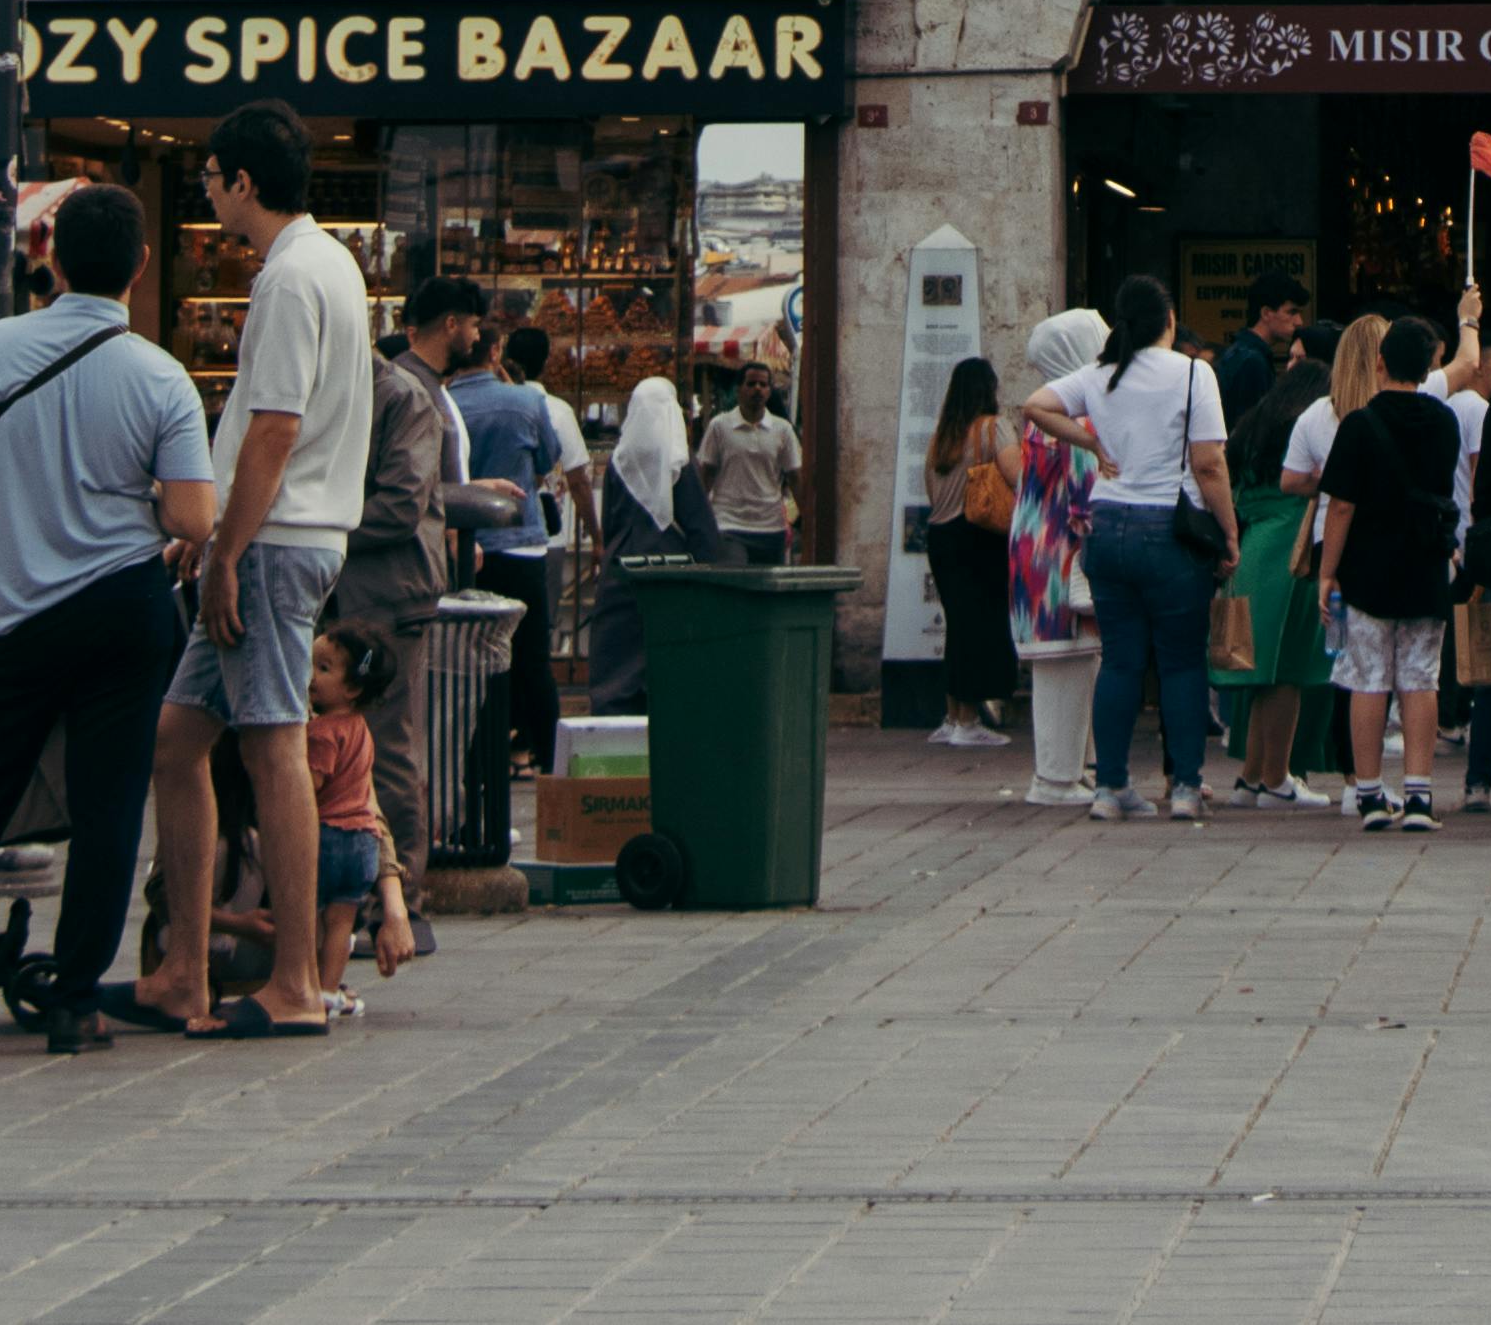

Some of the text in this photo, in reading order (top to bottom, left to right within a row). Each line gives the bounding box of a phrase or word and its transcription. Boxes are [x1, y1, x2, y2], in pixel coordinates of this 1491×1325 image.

[184, 16, 426, 84] SPICE
[457, 15, 823, 82] BAZAAR
[1328, 29, 1466, 62] MISIR
[1192, 253, 1238, 277] MISIR
